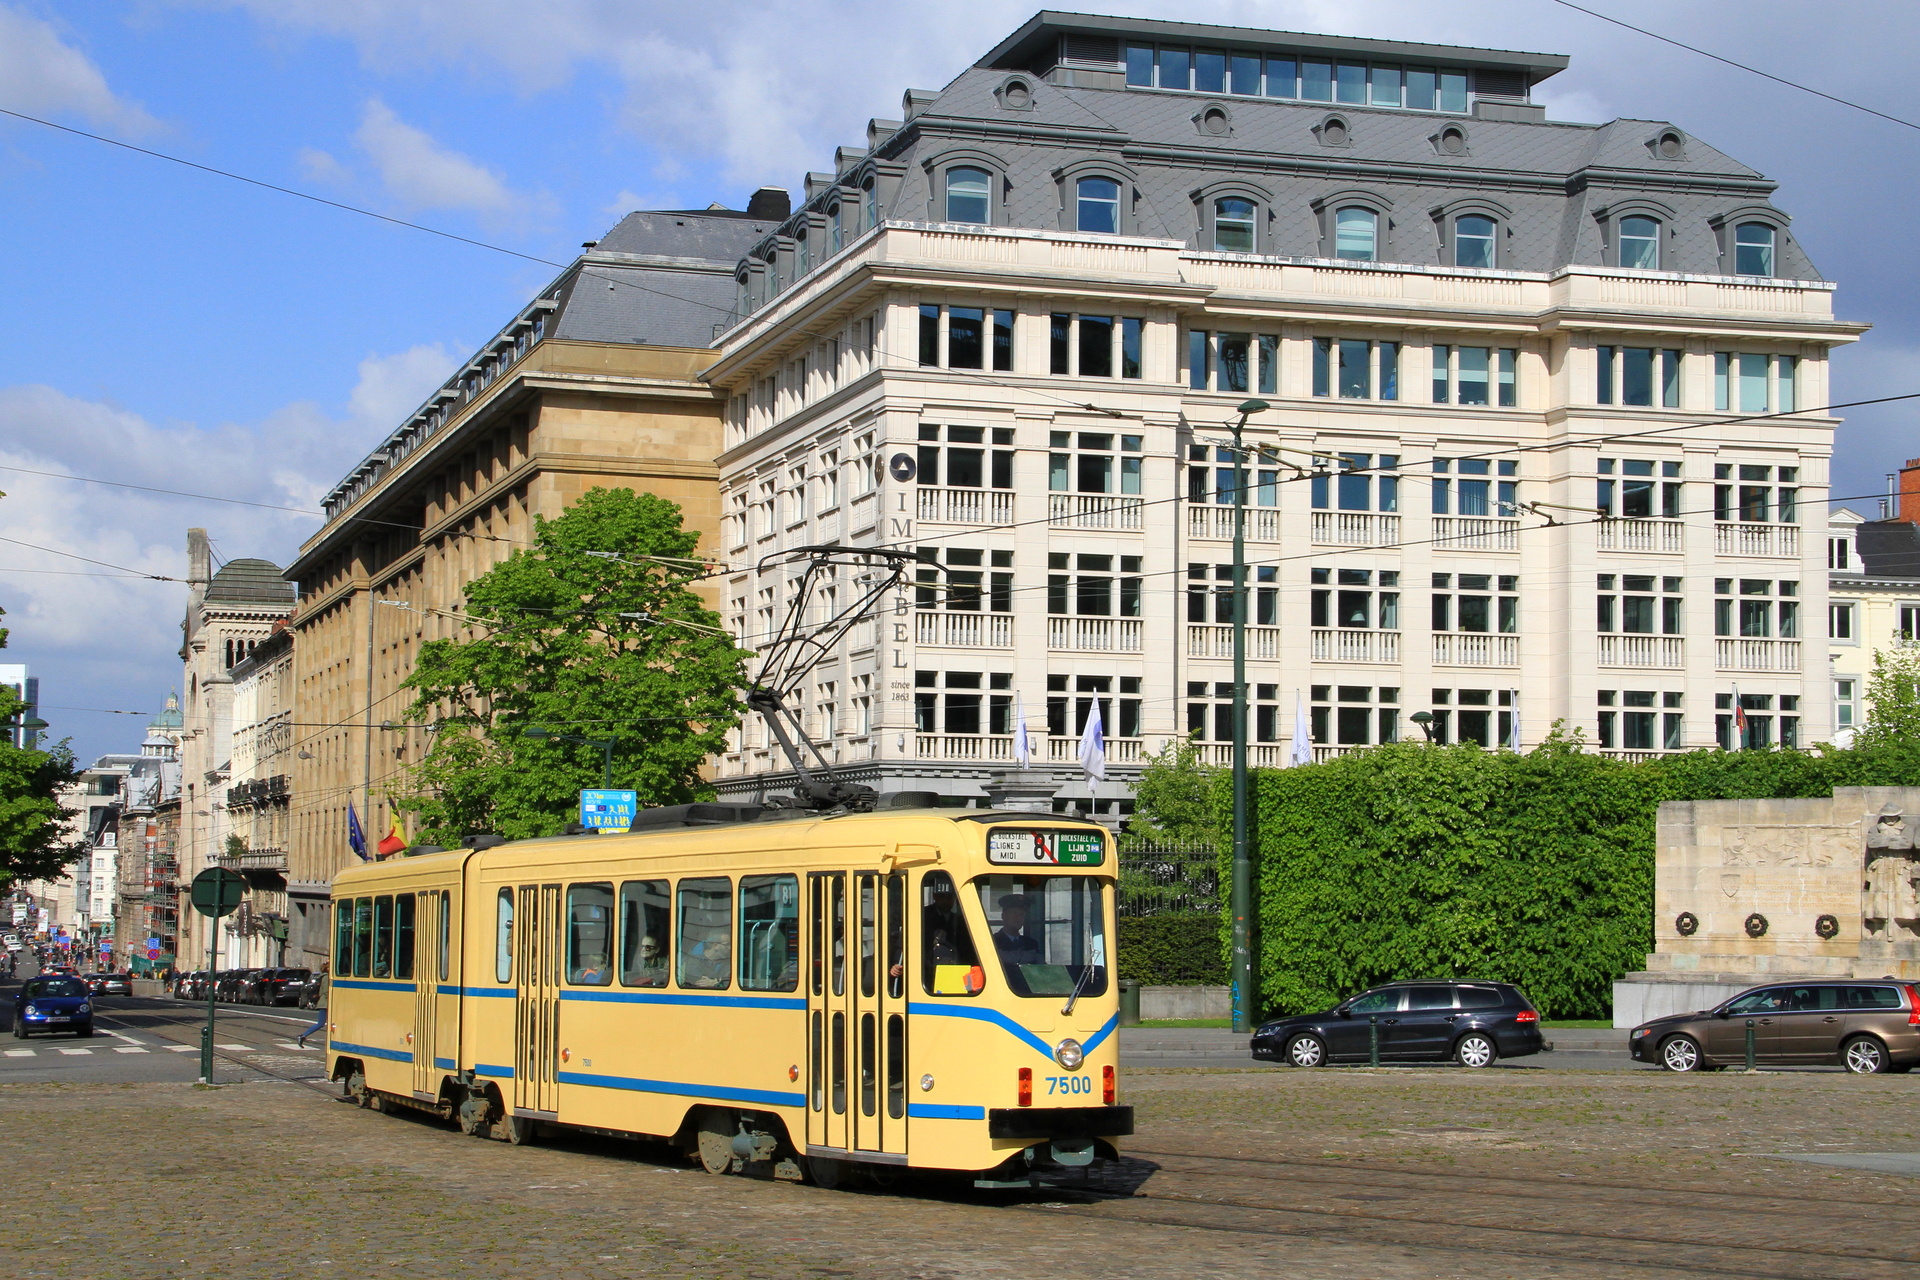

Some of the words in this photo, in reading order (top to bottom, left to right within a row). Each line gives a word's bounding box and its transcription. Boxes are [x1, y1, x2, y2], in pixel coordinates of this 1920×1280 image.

[890, 680, 910, 690] since
[891, 692, 910, 701] 1863
[996, 842, 1015, 850] LIGNE
[1016, 842, 1021, 850] 3
[1033, 833, 1055, 861] 81
[1068, 844, 1085, 852] LIJN
[1086, 844, 1091, 852] 3
[1000, 852, 1017, 860] MIDI
[1071, 853, 1088, 862] ZUID
[782, 885, 792, 905] 81
[1045, 1076, 1092, 1095] 7500
